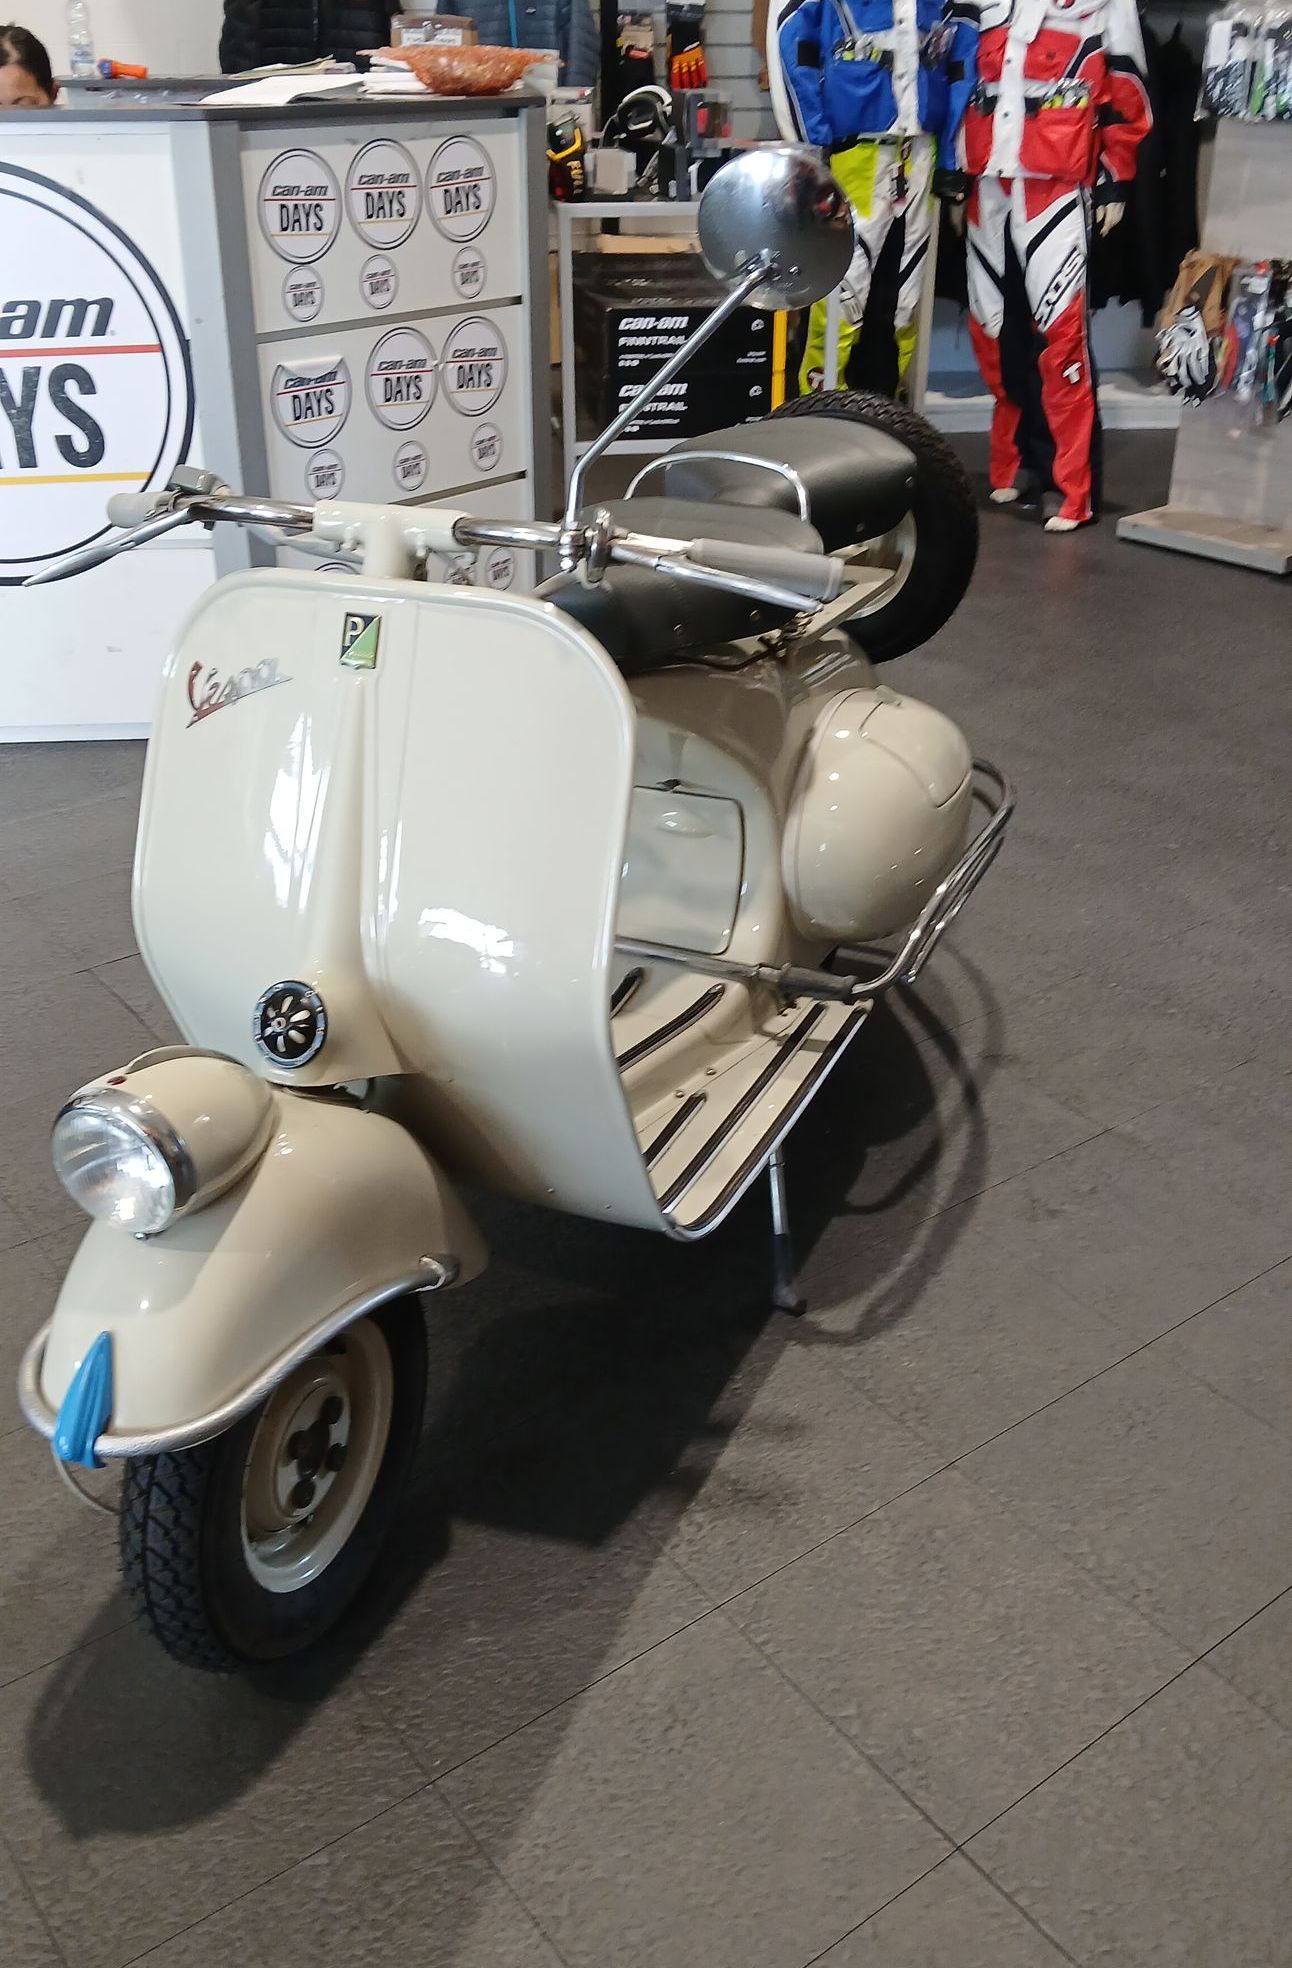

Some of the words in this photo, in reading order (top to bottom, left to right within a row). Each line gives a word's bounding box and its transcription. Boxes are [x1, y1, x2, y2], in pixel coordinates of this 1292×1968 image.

[358, 173, 410, 186] can-am
[436, 166, 485, 182] can-am
[271, 185, 329, 197] can-am
[443, 184, 482, 215] DAYS
[279, 203, 323, 232] DAYS
[365, 191, 405, 220] DAYS
[618, 316, 689, 331] can-am
[378, 358, 427, 371] can-am
[452, 347, 497, 359] can-am
[383, 375, 422, 403] DAYS
[456, 363, 493, 389] DAYS
[618, 383, 688, 397] caam
[0, 362, 105, 469] YS
[291, 388, 335, 421] DAYS
[345, 616, 366, 647] P
